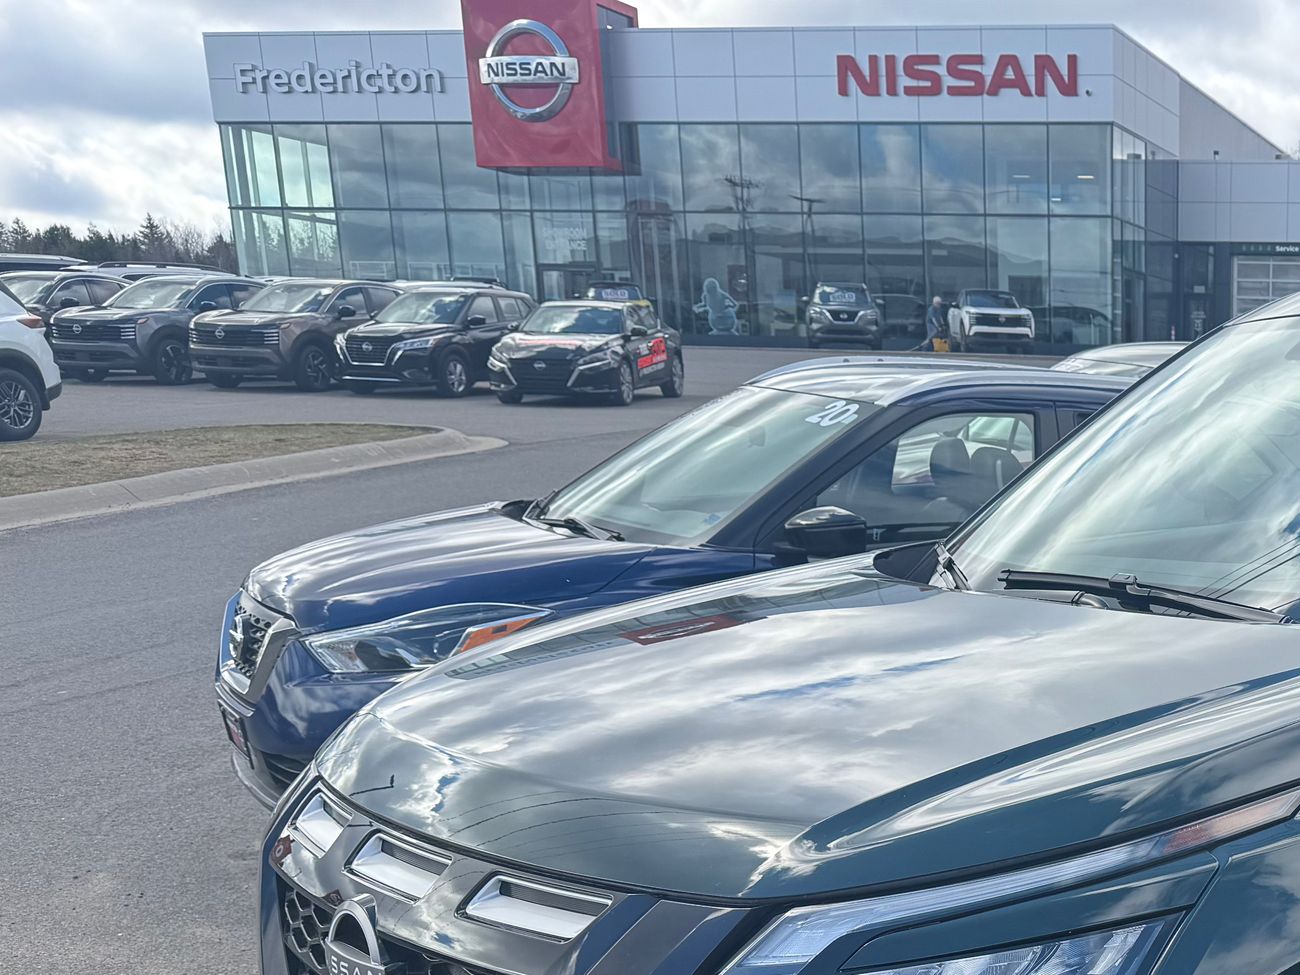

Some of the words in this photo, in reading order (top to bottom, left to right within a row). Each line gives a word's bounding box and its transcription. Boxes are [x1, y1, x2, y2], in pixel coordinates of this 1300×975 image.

[233, 59, 445, 94] Fredericton
[486, 62, 566, 78] NISSAN
[836, 53, 1079, 97] NISSAN
[1275, 245, 1299, 253] Service
